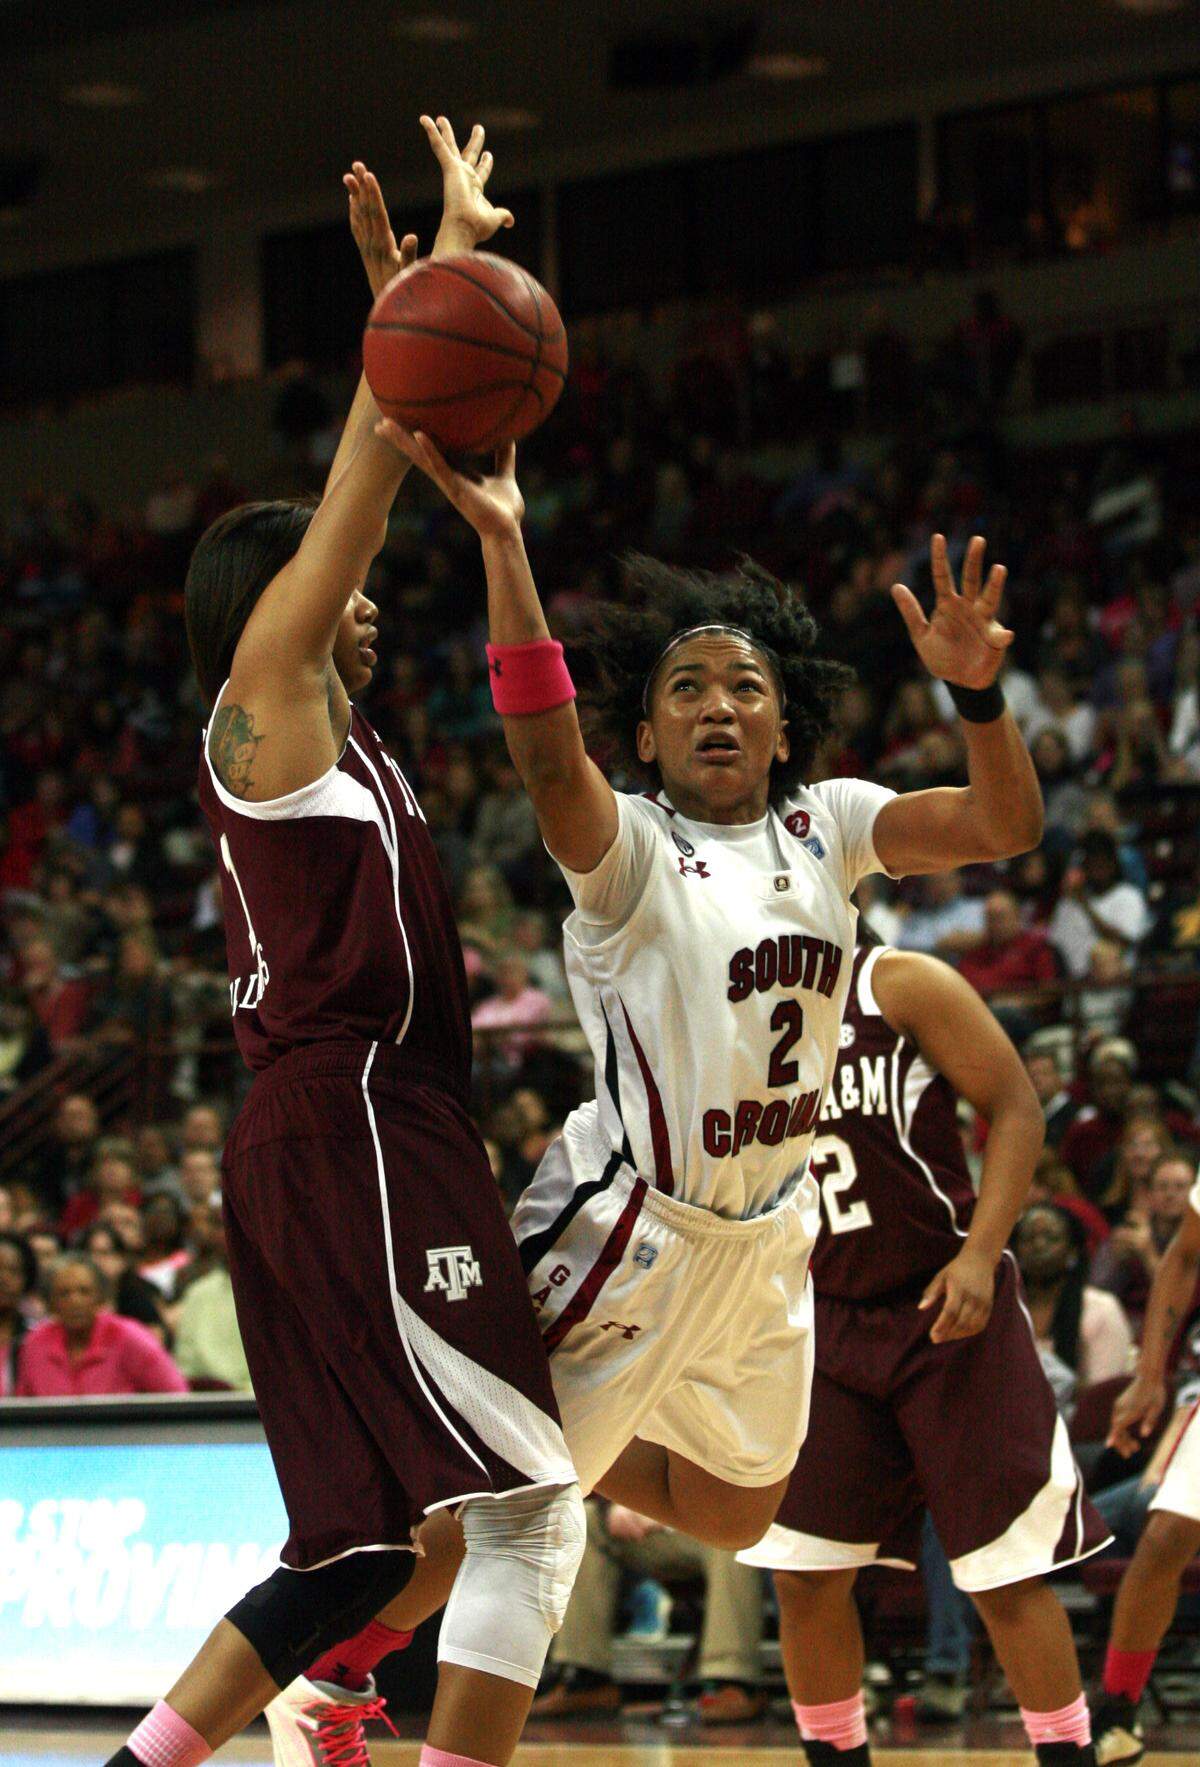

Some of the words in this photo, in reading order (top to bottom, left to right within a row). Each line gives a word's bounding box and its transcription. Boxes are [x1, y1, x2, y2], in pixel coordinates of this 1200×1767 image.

[791, 817, 808, 834] 2
[727, 934, 843, 1003] SOUTH
[767, 998, 804, 1088] 2
[819, 1055, 887, 1121] A&M
[811, 1134, 873, 1235] 2
[0, 1542, 283, 1628] PROVIN
